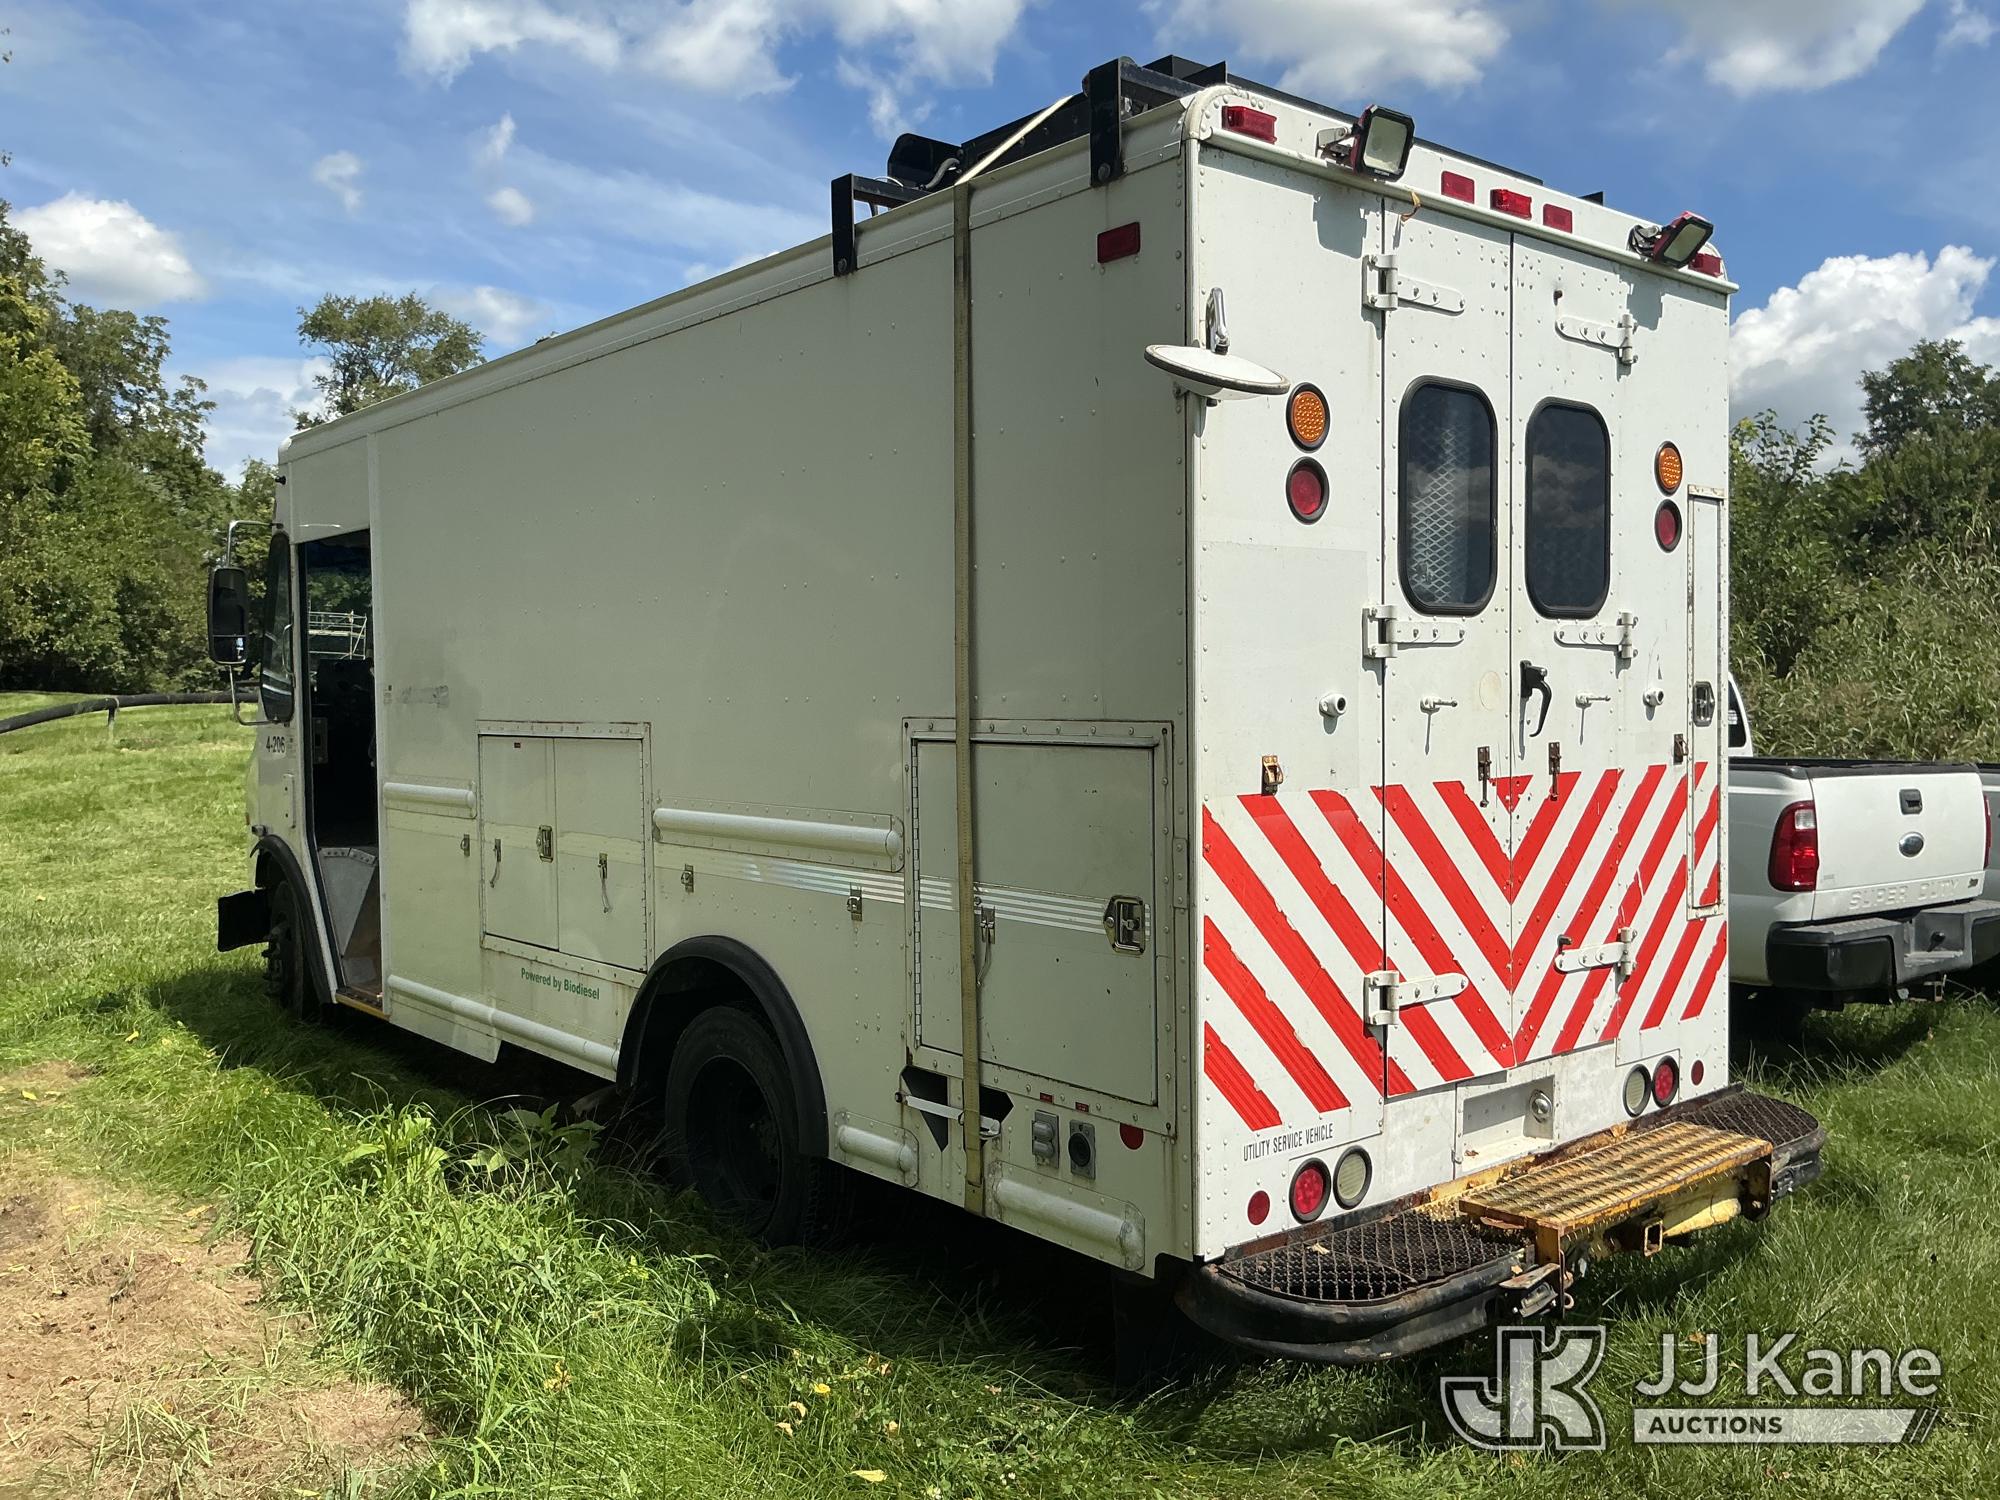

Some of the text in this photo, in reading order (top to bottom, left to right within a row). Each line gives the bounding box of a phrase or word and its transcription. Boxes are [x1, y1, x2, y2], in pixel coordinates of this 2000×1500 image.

[265, 735, 286, 754] 4-206
[521, 967, 600, 1000] Powered by Biodiesel
[1243, 1122, 1334, 1162] UTILITY SERVICE VEHICLE
